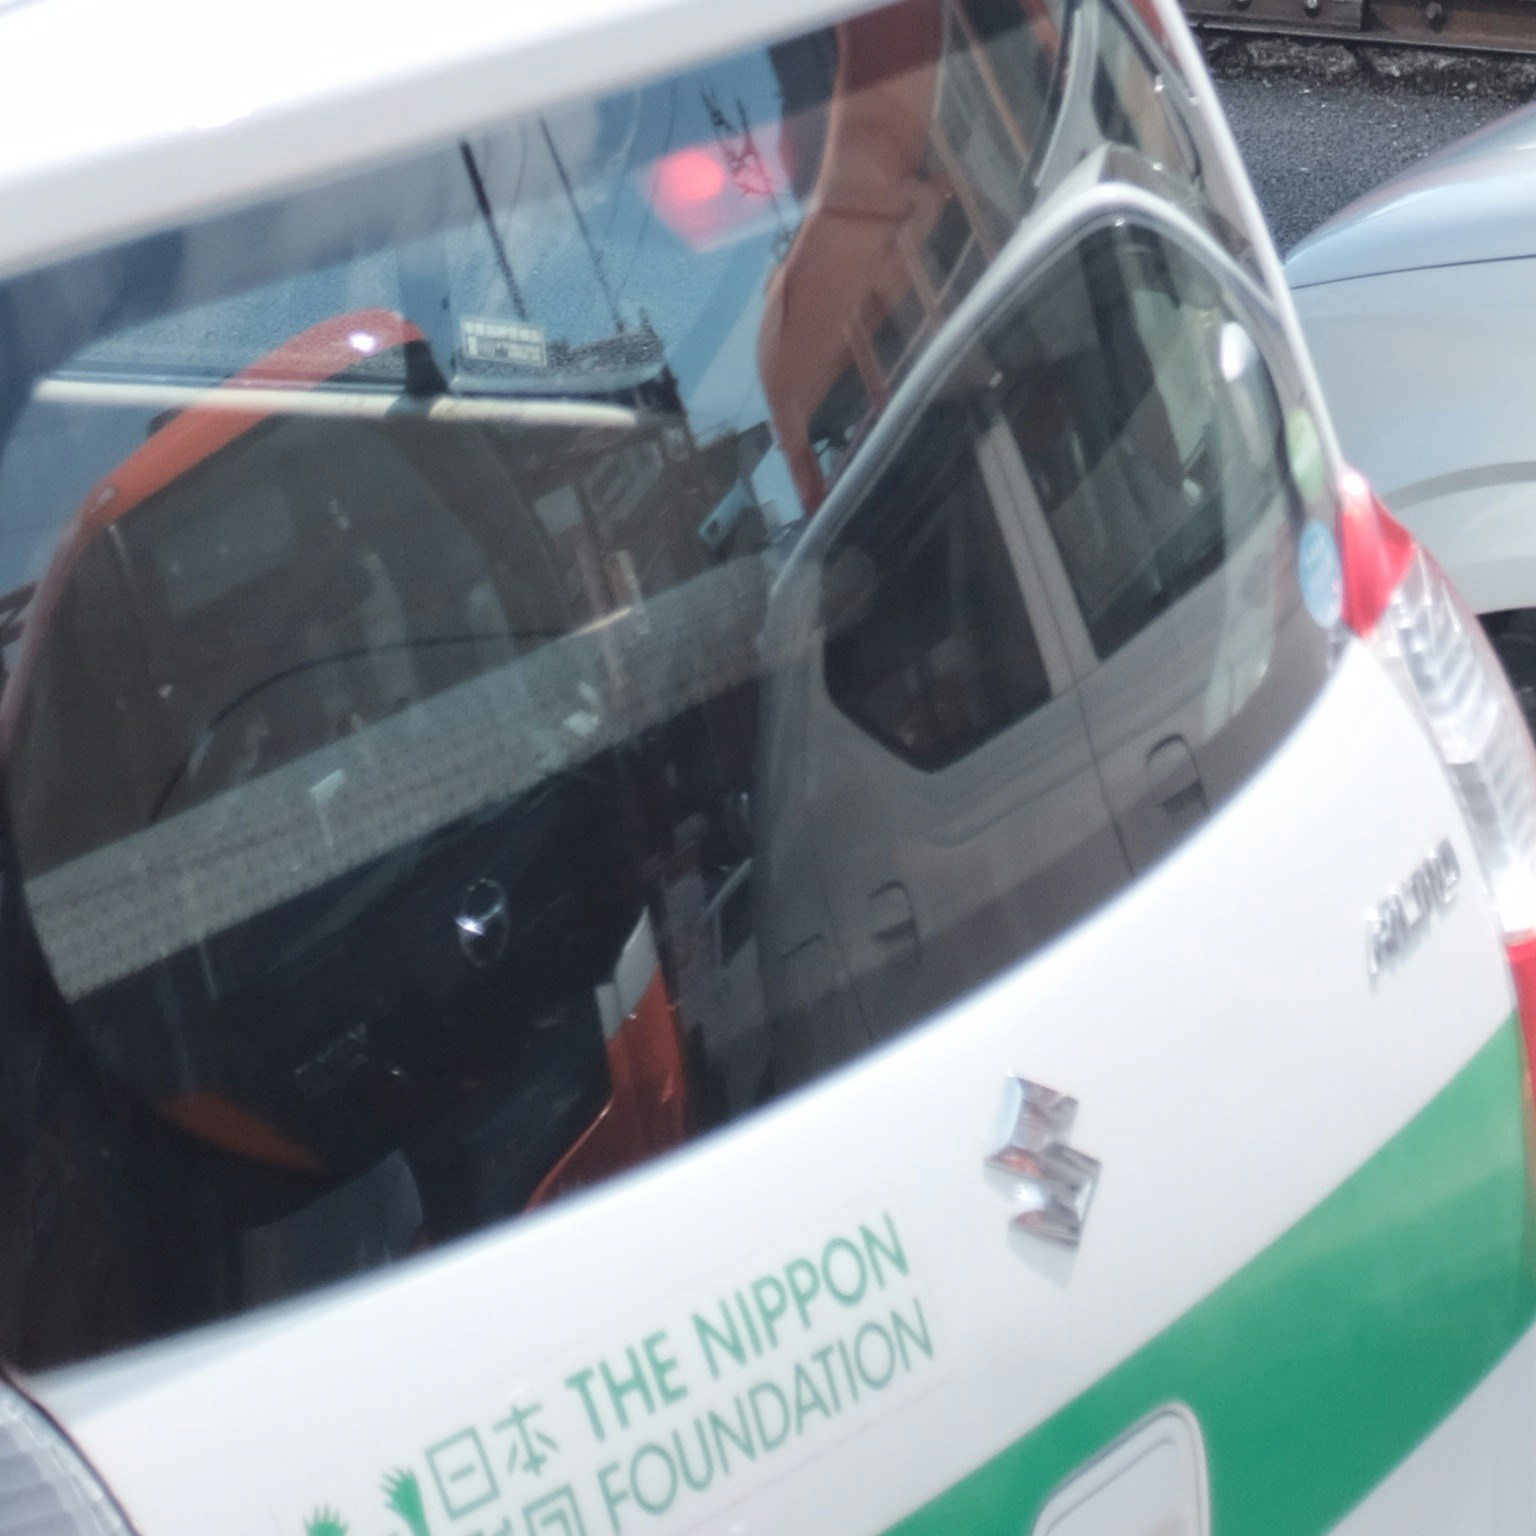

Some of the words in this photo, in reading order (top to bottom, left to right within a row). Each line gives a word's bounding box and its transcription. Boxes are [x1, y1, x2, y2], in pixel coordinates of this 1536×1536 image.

[564, 1330, 689, 1442] THE
[690, 1212, 910, 1381] NIPPON
[597, 1296, 935, 1536] FOUNDATION
[424, 1403, 559, 1521] 日本
